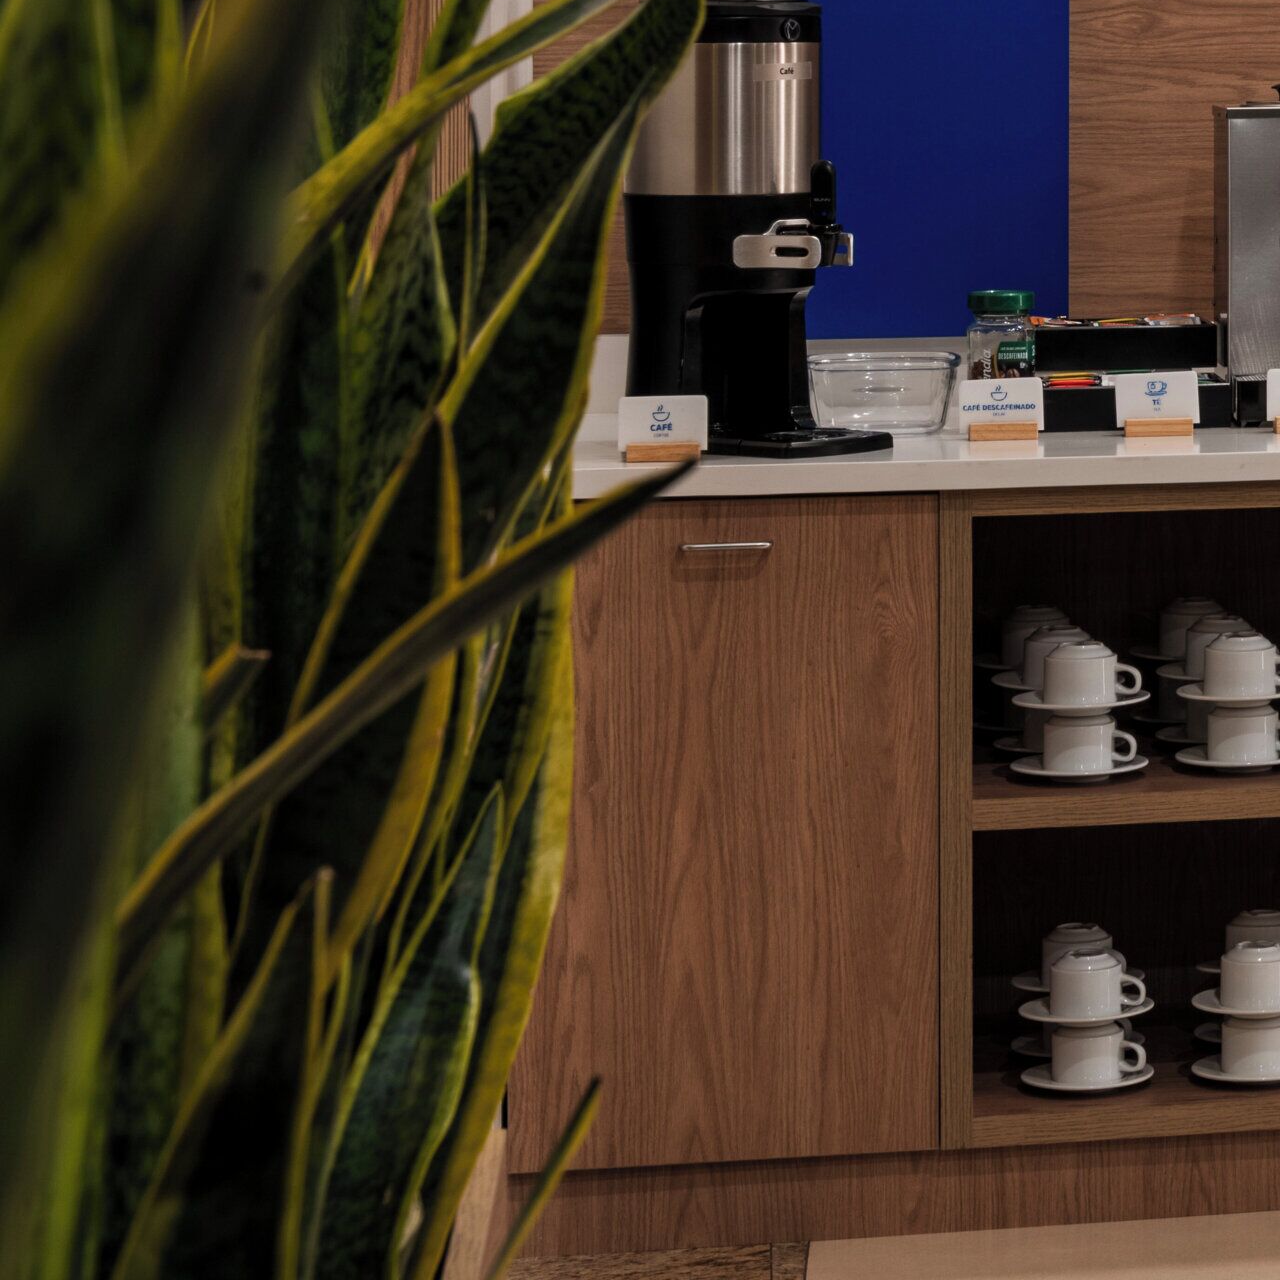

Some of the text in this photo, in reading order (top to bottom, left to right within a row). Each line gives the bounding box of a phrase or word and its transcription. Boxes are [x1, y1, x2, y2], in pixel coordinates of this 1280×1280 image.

[780, 67, 794, 75] Café
[962, 403, 1036, 411] CAFÉ DESCAFEINADO
[650, 422, 673, 432] CAFÉ
